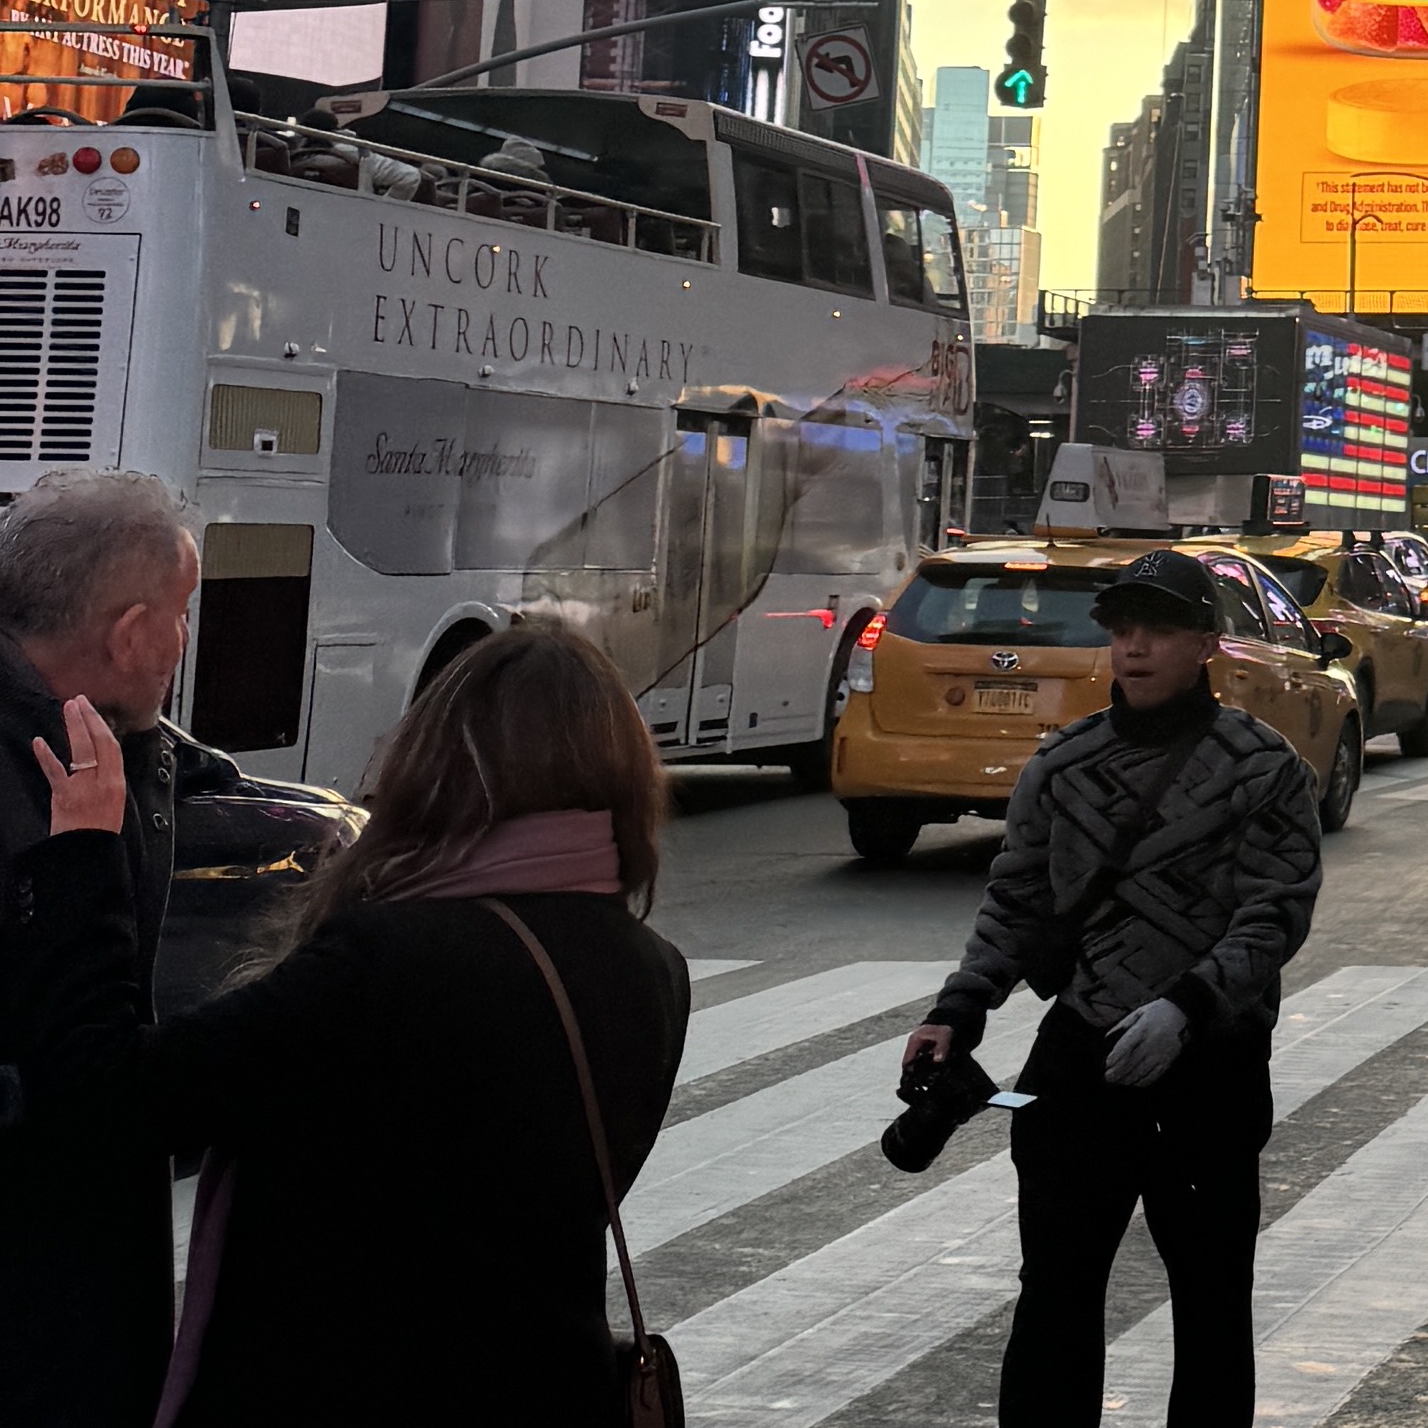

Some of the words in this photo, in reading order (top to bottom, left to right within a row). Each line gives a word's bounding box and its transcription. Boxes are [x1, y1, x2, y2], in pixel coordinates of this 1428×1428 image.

[62, 31, 120, 60] ACTRESS
[122, 42, 151, 70] THIS
[1387, 181, 1402, 193] has
[0, 196, 61, 228] AK98
[1311, 201, 1327, 212] and
[1330, 201, 1350, 215] Drug
[1326, 220, 1334, 231] to
[1406, 222, 1426, 231] cure
[379, 223, 550, 299] UNCORK
[373, 294, 693, 384] EXTRAORDINARY
[367, 432, 432, 475] Santa
